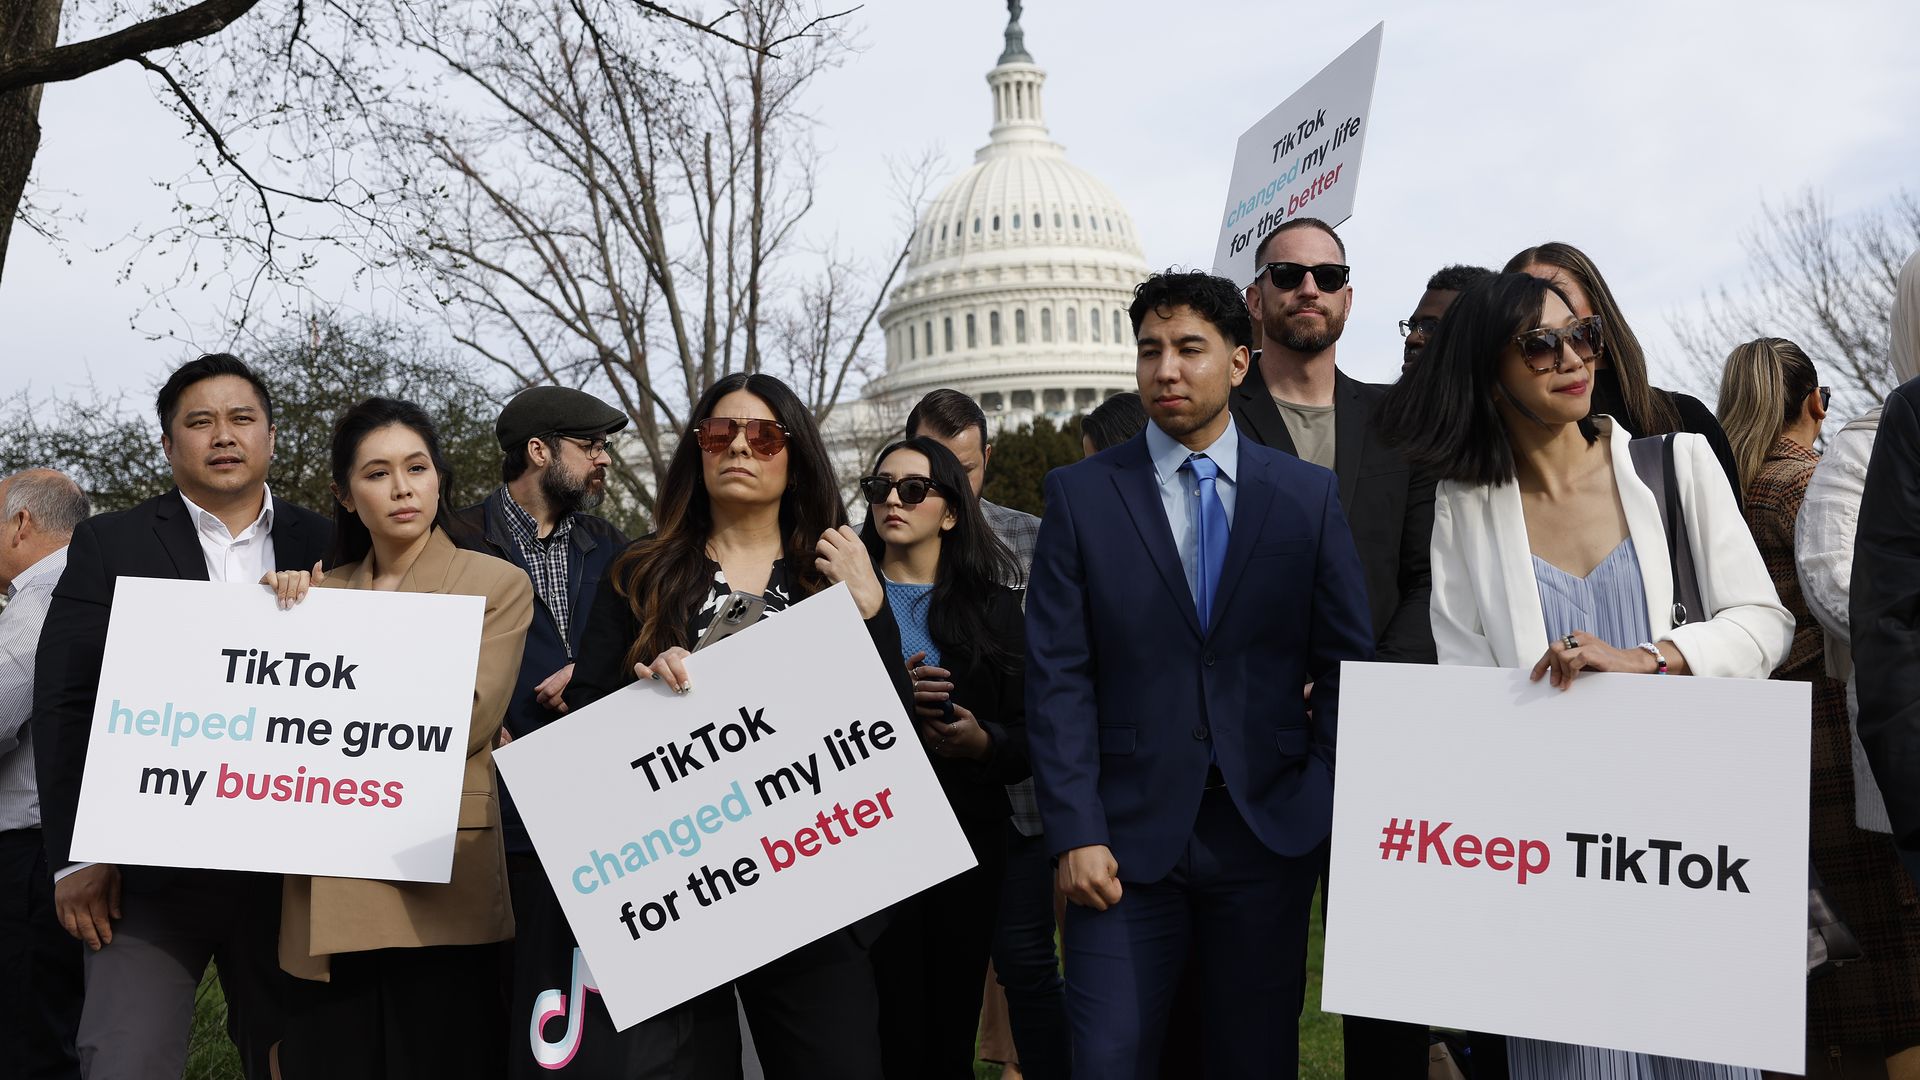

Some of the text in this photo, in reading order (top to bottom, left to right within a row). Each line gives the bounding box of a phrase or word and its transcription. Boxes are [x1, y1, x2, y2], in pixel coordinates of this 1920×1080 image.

[1226, 116, 1361, 228] changed my life
[1273, 108, 1327, 164] TikTok
[1229, 162, 1344, 258] for the better
[221, 648, 359, 690] TikTok
[107, 699, 453, 758] helped me grow
[630, 706, 777, 793] TikTok
[139, 762, 404, 809] my business
[572, 719, 898, 895] changed my life
[619, 787, 895, 942] for the better
[1379, 817, 1751, 894] #Keep TikTok
